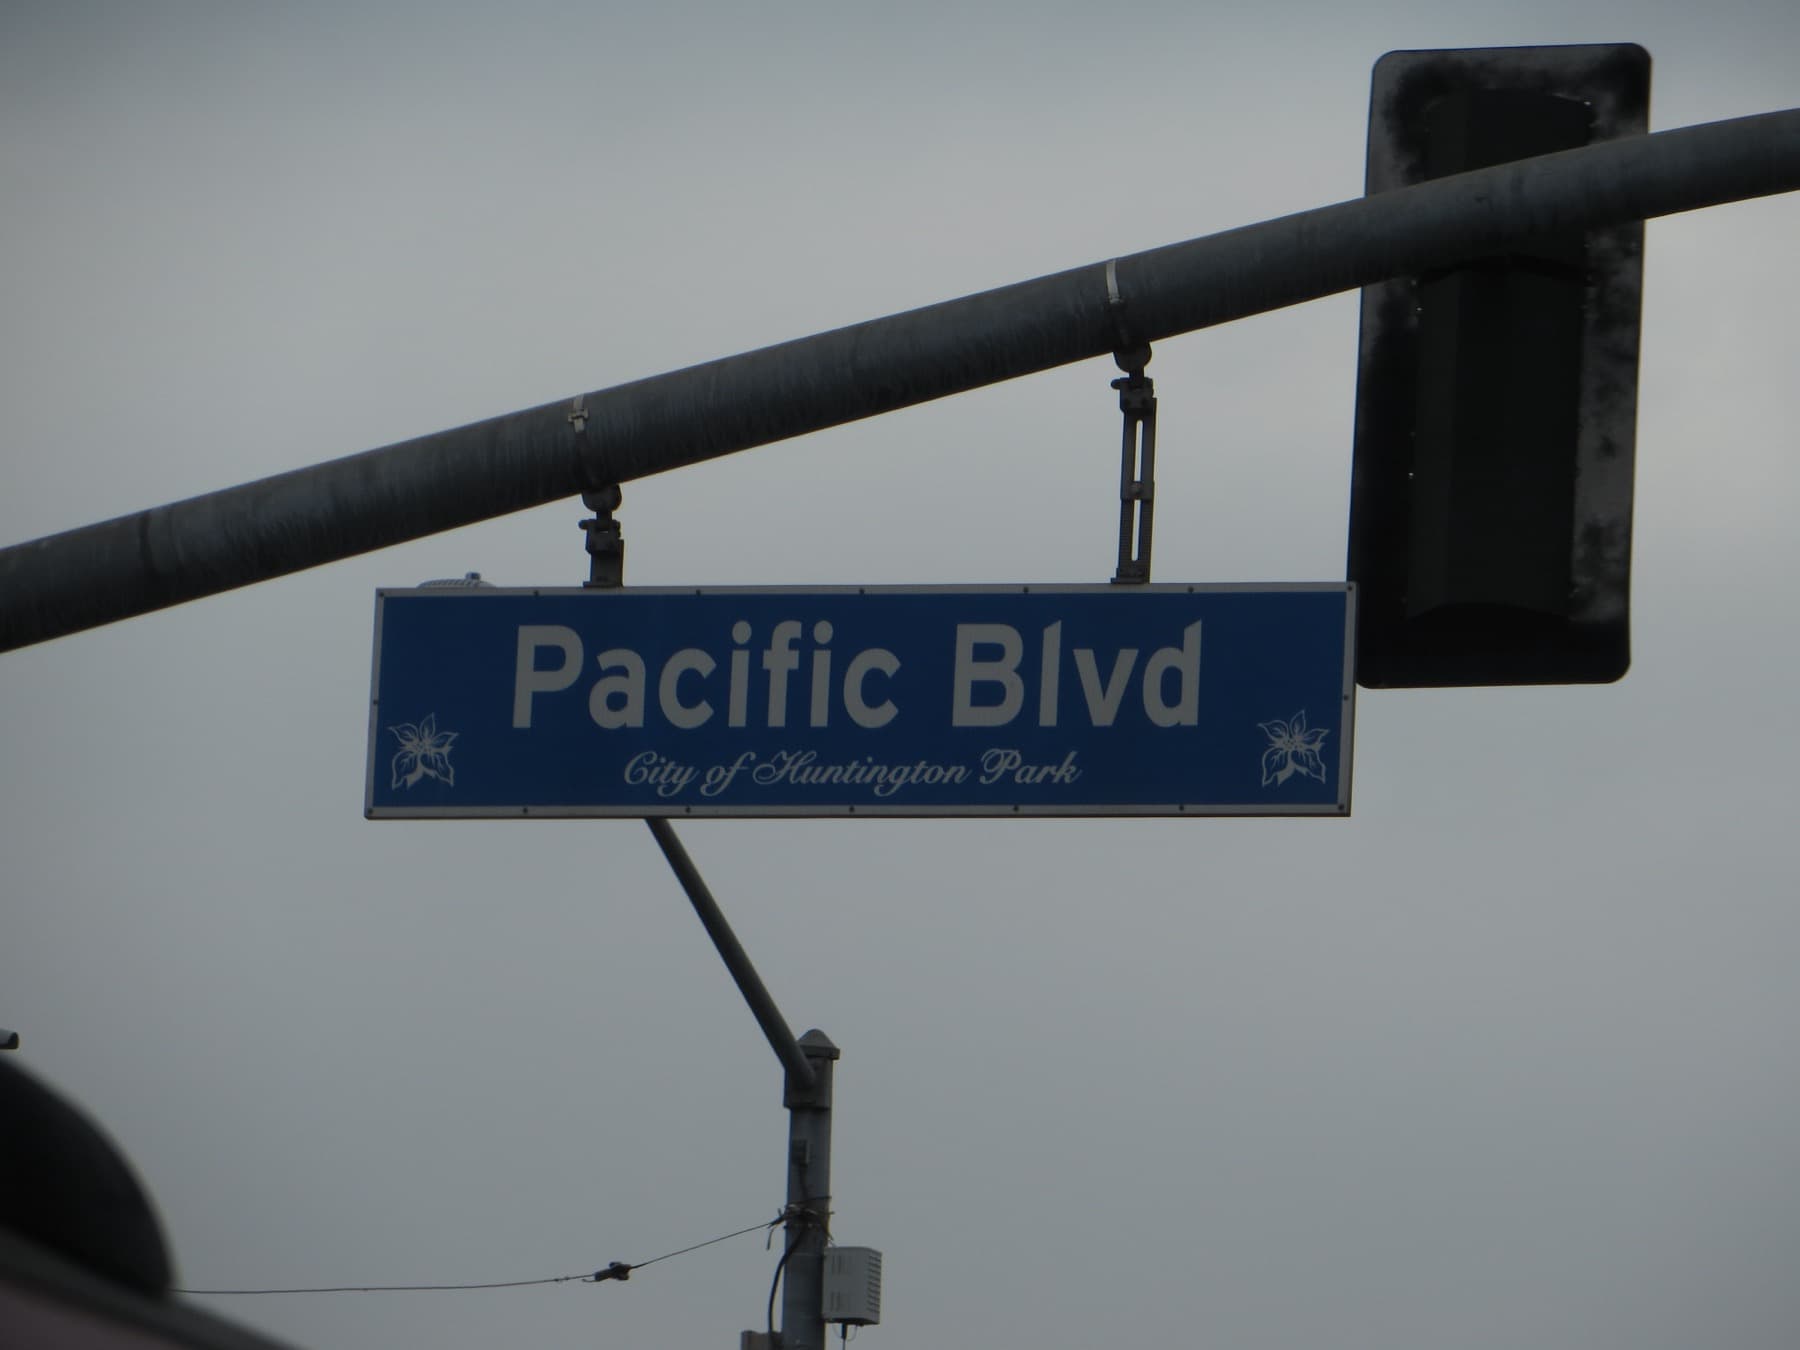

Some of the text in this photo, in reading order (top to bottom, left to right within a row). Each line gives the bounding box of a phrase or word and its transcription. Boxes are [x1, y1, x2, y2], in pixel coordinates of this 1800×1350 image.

[512, 620, 1202, 729] Pacific Blvd
[623, 748, 1083, 797] City of Huntington Park
